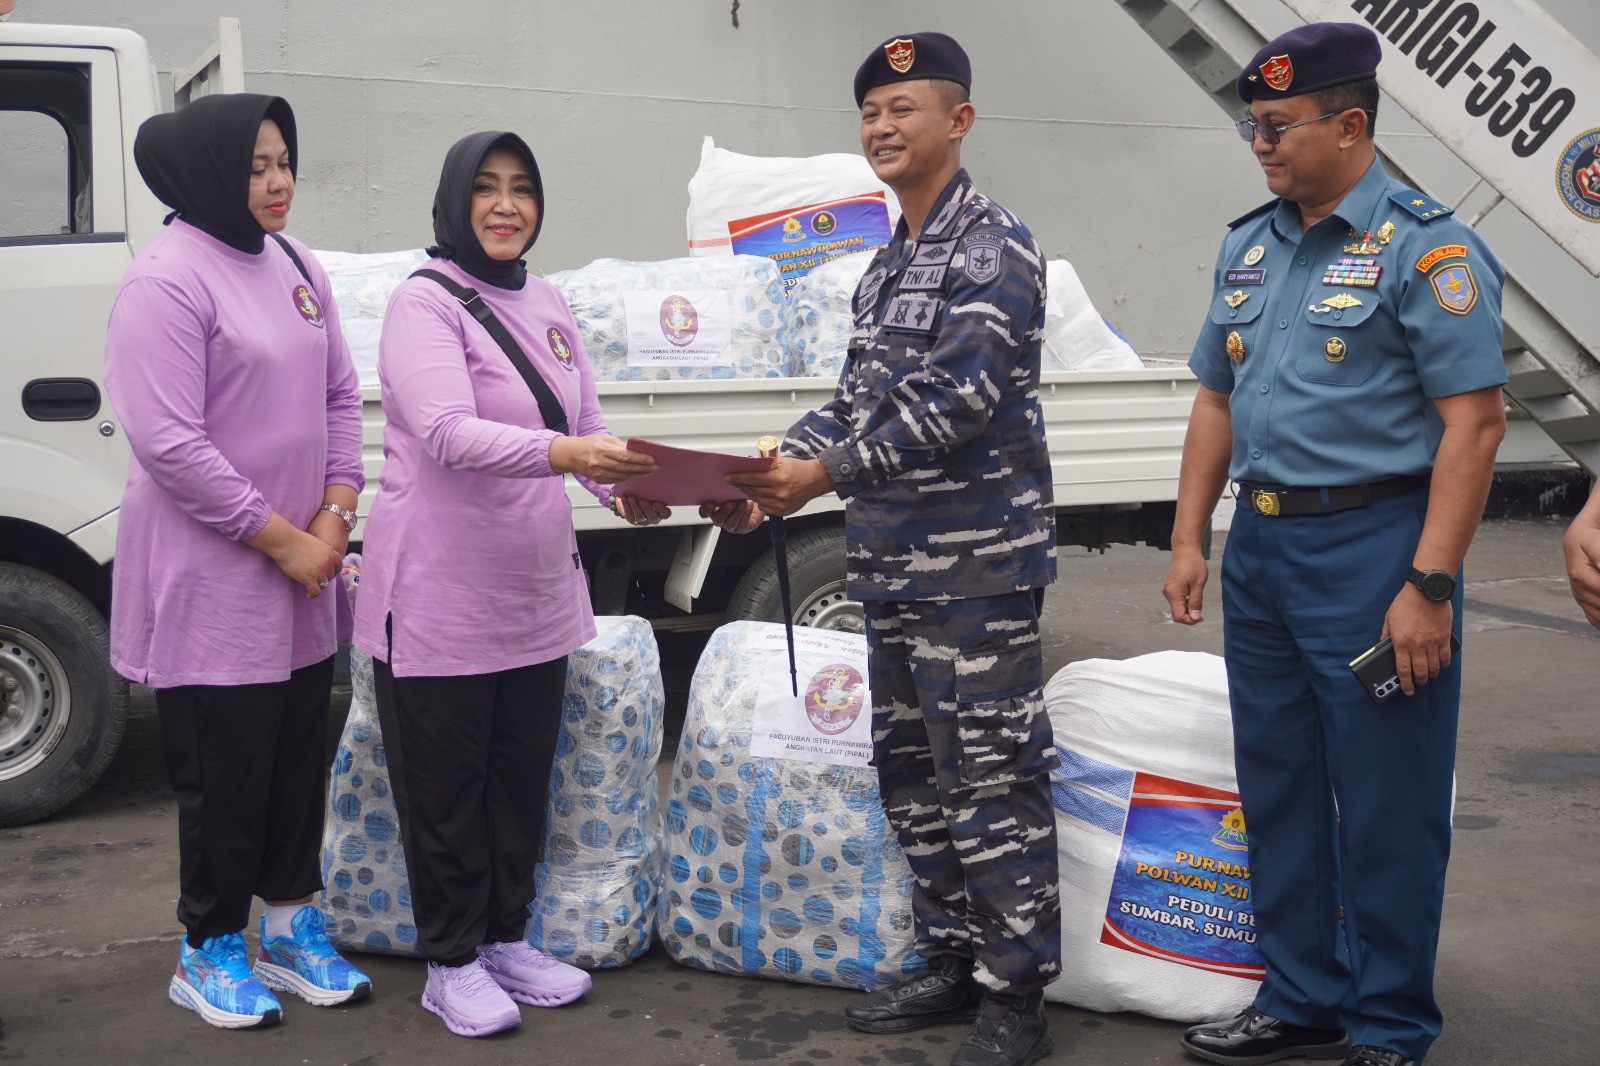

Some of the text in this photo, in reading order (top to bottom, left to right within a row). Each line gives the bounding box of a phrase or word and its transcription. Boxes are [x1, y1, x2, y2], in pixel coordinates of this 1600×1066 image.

[1561, 158, 1577, 200] FROSCH
[1420, 247, 1464, 270] KOLINLAMIL
[905, 269, 940, 285] TNI AL
[785, 743, 870, 759] ANGKATAN LAUT (PIPAL)
[812, 737, 830, 745] ISTRI
[1135, 861, 1249, 901] POLWAN XII
[1119, 901, 1200, 934] SUMBAR,
[1167, 894, 1234, 922] PEDULI
